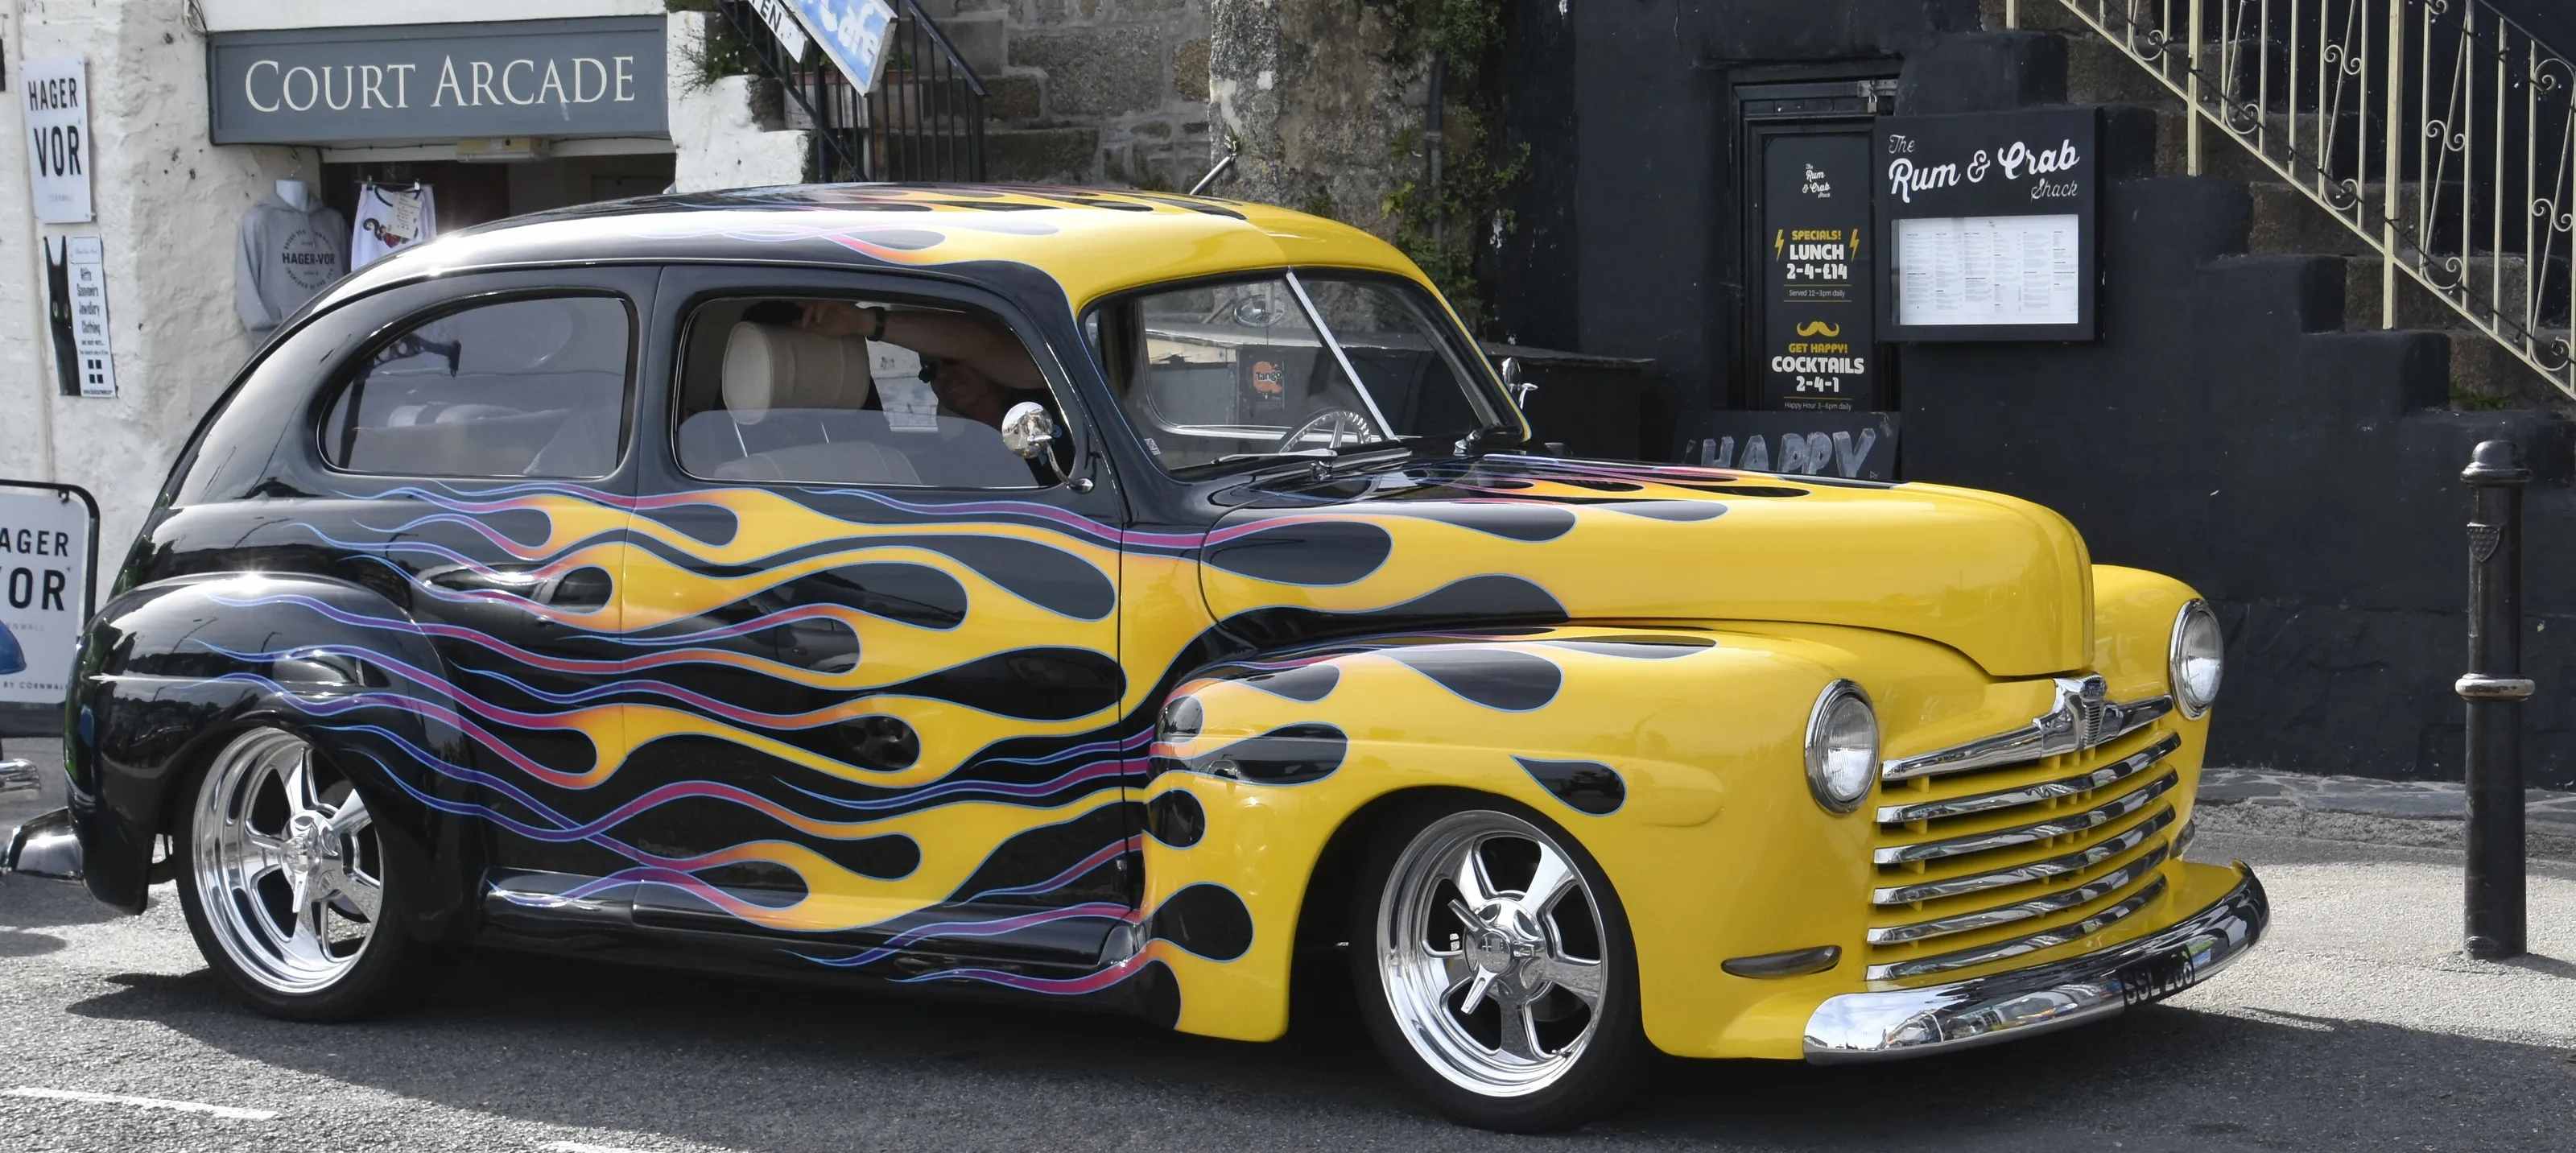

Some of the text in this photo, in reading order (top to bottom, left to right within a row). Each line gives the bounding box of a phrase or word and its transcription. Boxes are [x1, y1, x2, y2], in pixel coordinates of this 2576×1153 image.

[245, 55, 635, 113] COURT ARCADE
[28, 77, 78, 111] HAGER
[33, 126, 81, 177] VOR
[1889, 134, 1915, 154] The
[1806, 170, 1825, 182] Rum
[1888, 138, 2080, 203] Rum & Crab
[1802, 182, 1831, 193] & Crab
[2030, 178, 2078, 202] Shack
[1791, 229, 1842, 241] SPECIALS!
[282, 252, 335, 265] HAGER-VOR
[1790, 244, 1844, 261] LUNCH
[1786, 263, 1847, 279] 2-4-£14
[1832, 289, 1845, 299] daily
[1788, 343, 1848, 353] GET HAPPY!
[1772, 356, 1864, 374] COCKTAILS
[1256, 371, 1282, 382] Tango
[1796, 375, 1839, 392] 2-4-1
[1784, 402, 1802, 410] Happy
[1839, 403, 1852, 411] daily
[1700, 428, 1876, 478] HAPPY
[0, 527, 69, 557] AGER
[0, 567, 65, 611] OR
